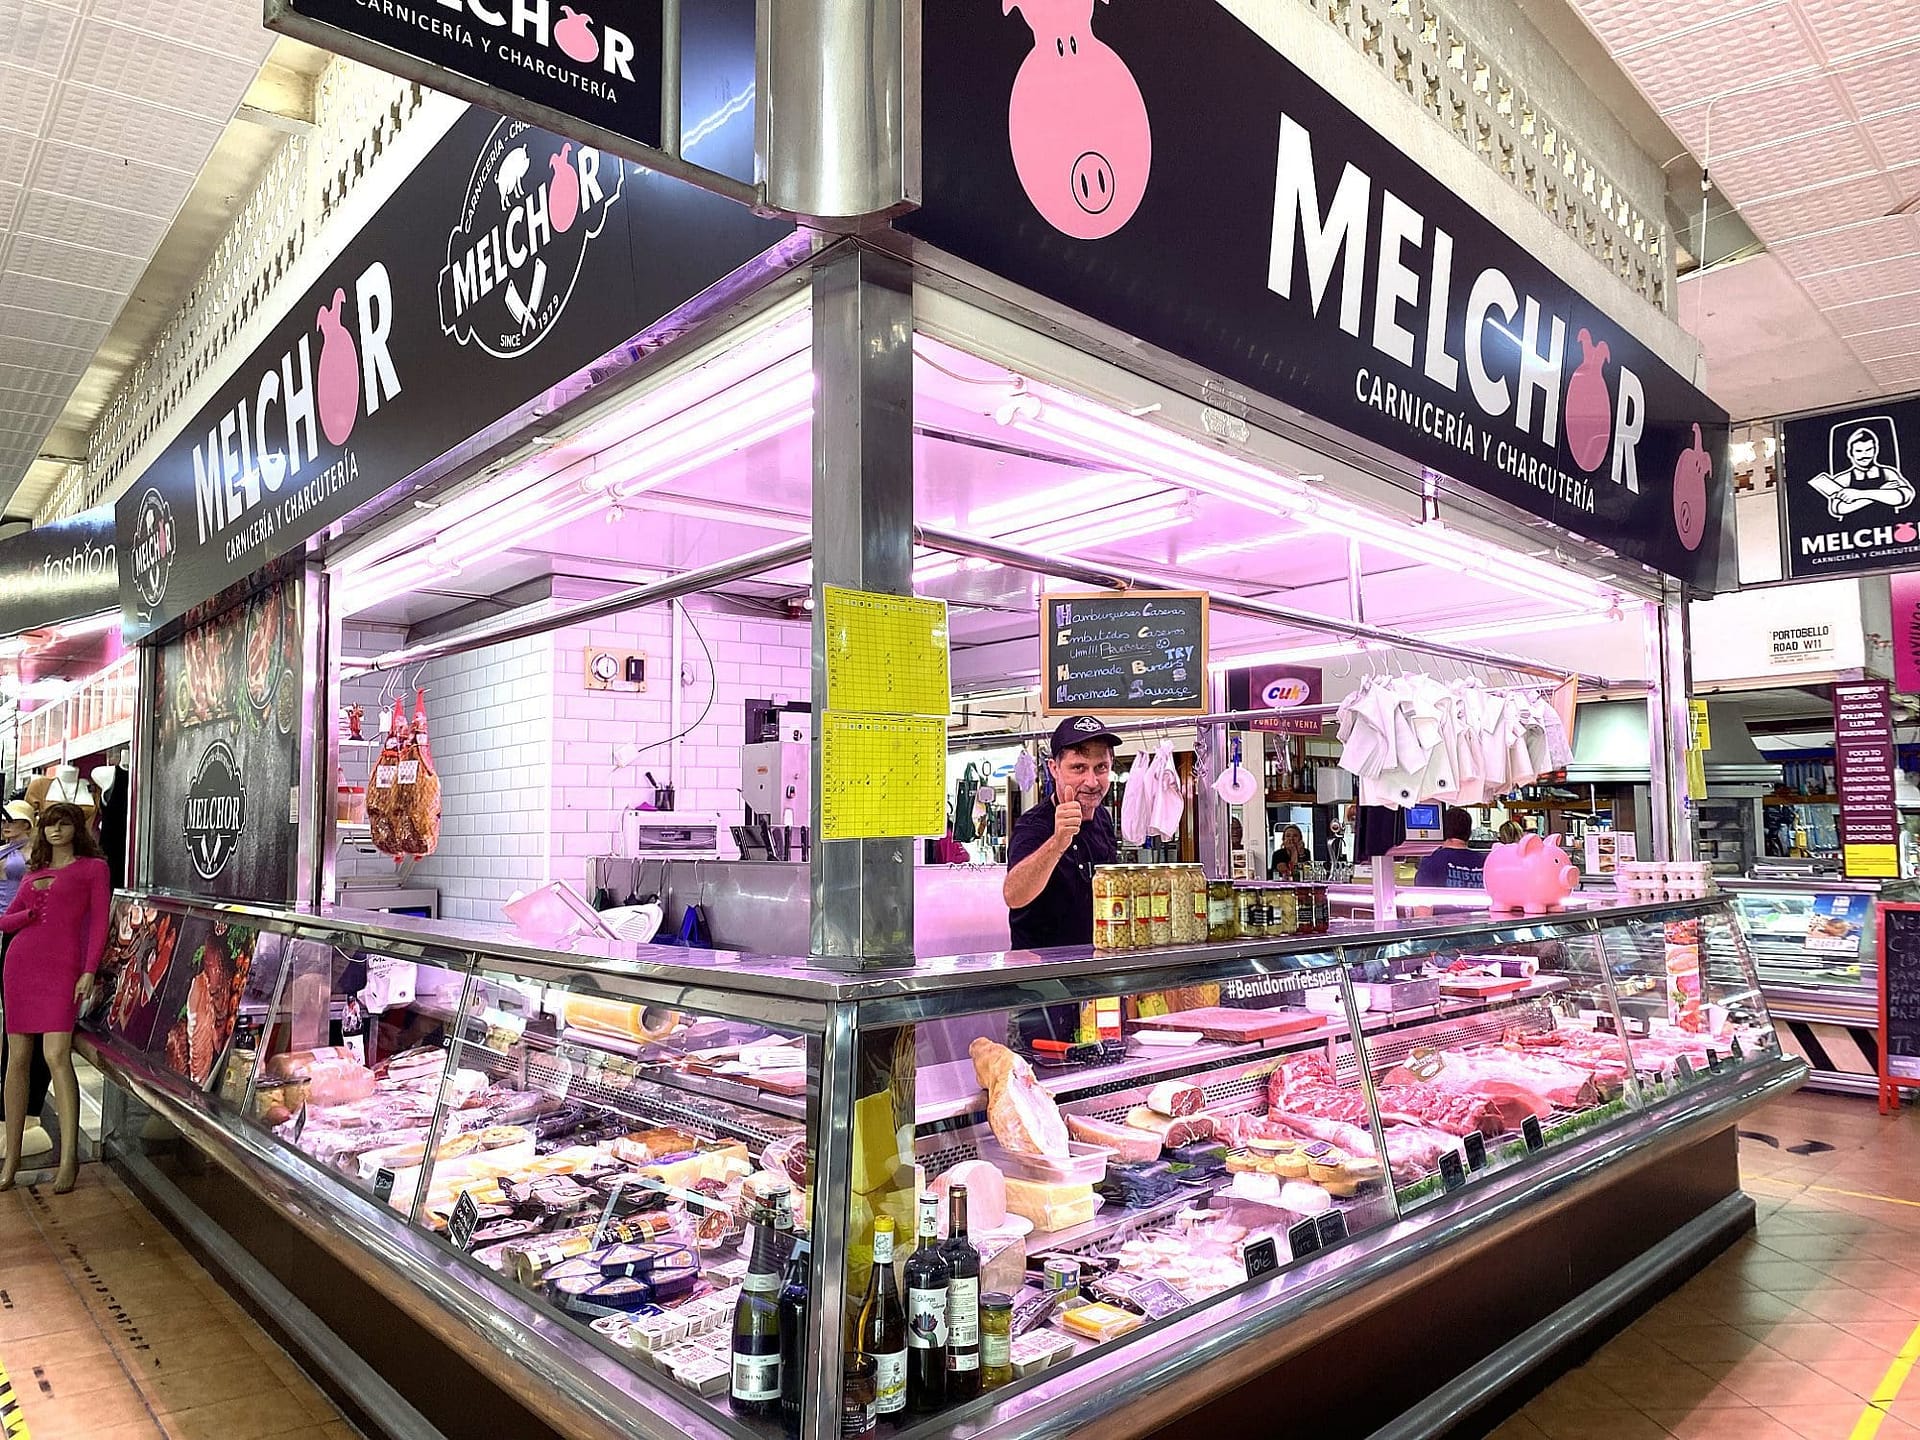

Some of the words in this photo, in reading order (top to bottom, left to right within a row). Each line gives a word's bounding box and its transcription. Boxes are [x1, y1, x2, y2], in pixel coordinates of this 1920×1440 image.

[481, 37, 492, 54] Y
[499, 45, 618, 104] CHARCUTERÍA
[452, 143, 605, 318] MELCHOR
[500, 333, 521, 348] SINCE
[537, 293, 560, 330] 1979
[1267, 111, 1645, 496] MELCHOR
[192, 261, 402, 546] MELCHOR
[1355, 367, 1475, 452] CARNICERÍA
[1481, 431, 1493, 463] Y
[1496, 440, 1596, 515] CHARCUTERÍA
[225, 512, 274, 563] CARNICERÍA
[276, 505, 283, 531] Y
[284, 447, 359, 526] CHARCUTERÍA
[43, 538, 119, 586] fashion
[1057, 627, 1130, 646] Embutidos
[1772, 625, 1829, 641] PORTOBELLO
[1773, 641, 1799, 653] ROAD
[1803, 639, 1822, 650] W11
[1164, 645, 1195, 662] TRY
[1057, 663, 1124, 682] Homemade
[1056, 683, 1120, 704] Homemade
[1295, 718, 1318, 729] VENTA
[186, 796, 240, 830] MELCHOR
[1227, 967, 1344, 999] #BenidormTeEspera
